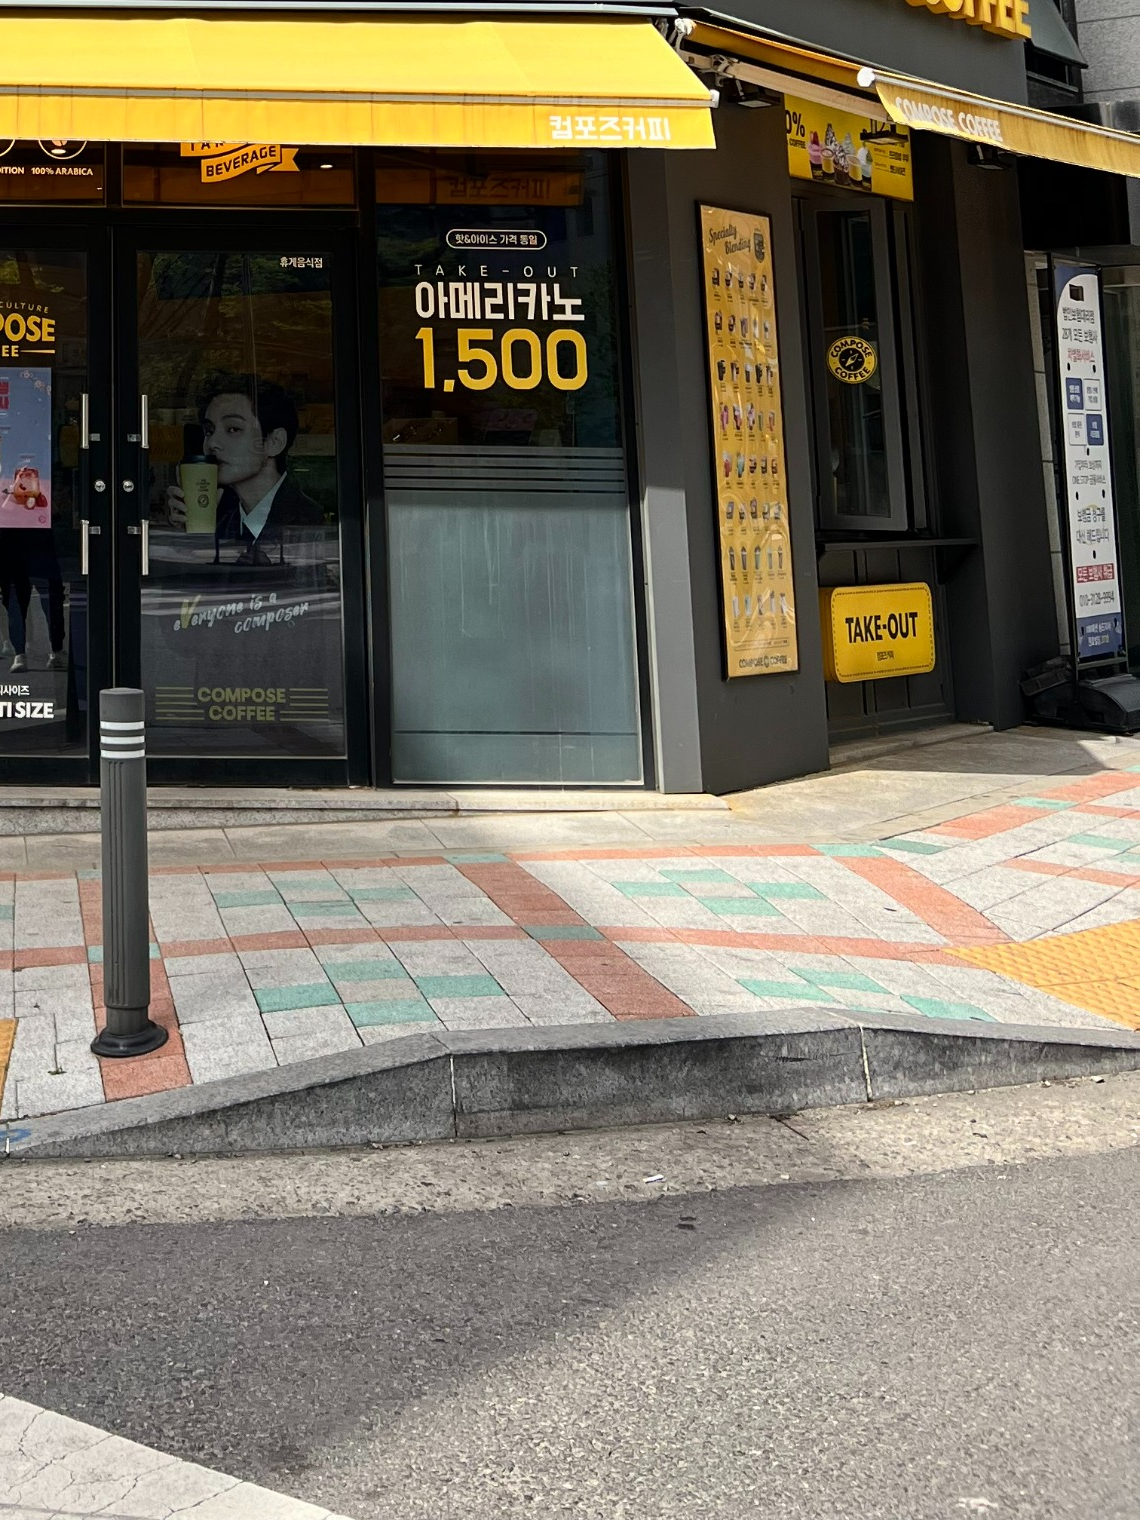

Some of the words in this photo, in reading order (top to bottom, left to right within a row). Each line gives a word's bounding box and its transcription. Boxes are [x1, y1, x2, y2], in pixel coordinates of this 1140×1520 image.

[549, 116, 671, 141] 컴포즈커피
[895, 96, 956, 130] COMPOSE
[958, 111, 1003, 143] COFFEE
[205, 145, 277, 178] BEVERAGE
[31, 166, 54, 176] 100%
[55, 168, 94, 177] ARABICA
[455, 233, 498, 246] 핫&아이스
[500, 233, 518, 246] 가격
[709, 223, 737, 245] Specialty
[725, 238, 751, 256] Blending
[280, 256, 323, 269] 휴게음식점
[415, 264, 580, 278] TAKE-OUT
[415, 281, 585, 321] 아메리카노
[831, 340, 872, 357] COMPOSE
[415, 327, 588, 393] 1,500
[835, 367, 870, 380] COFFEE
[250, 593, 264, 612] is
[268, 593, 278, 605] a
[234, 602, 309, 634] composer
[845, 612, 918, 643] TAKE-OUT
[197, 687, 286, 703] COMPOSE
[15, 702, 54, 719] SIZE
[209, 706, 275, 721] COFFEE
